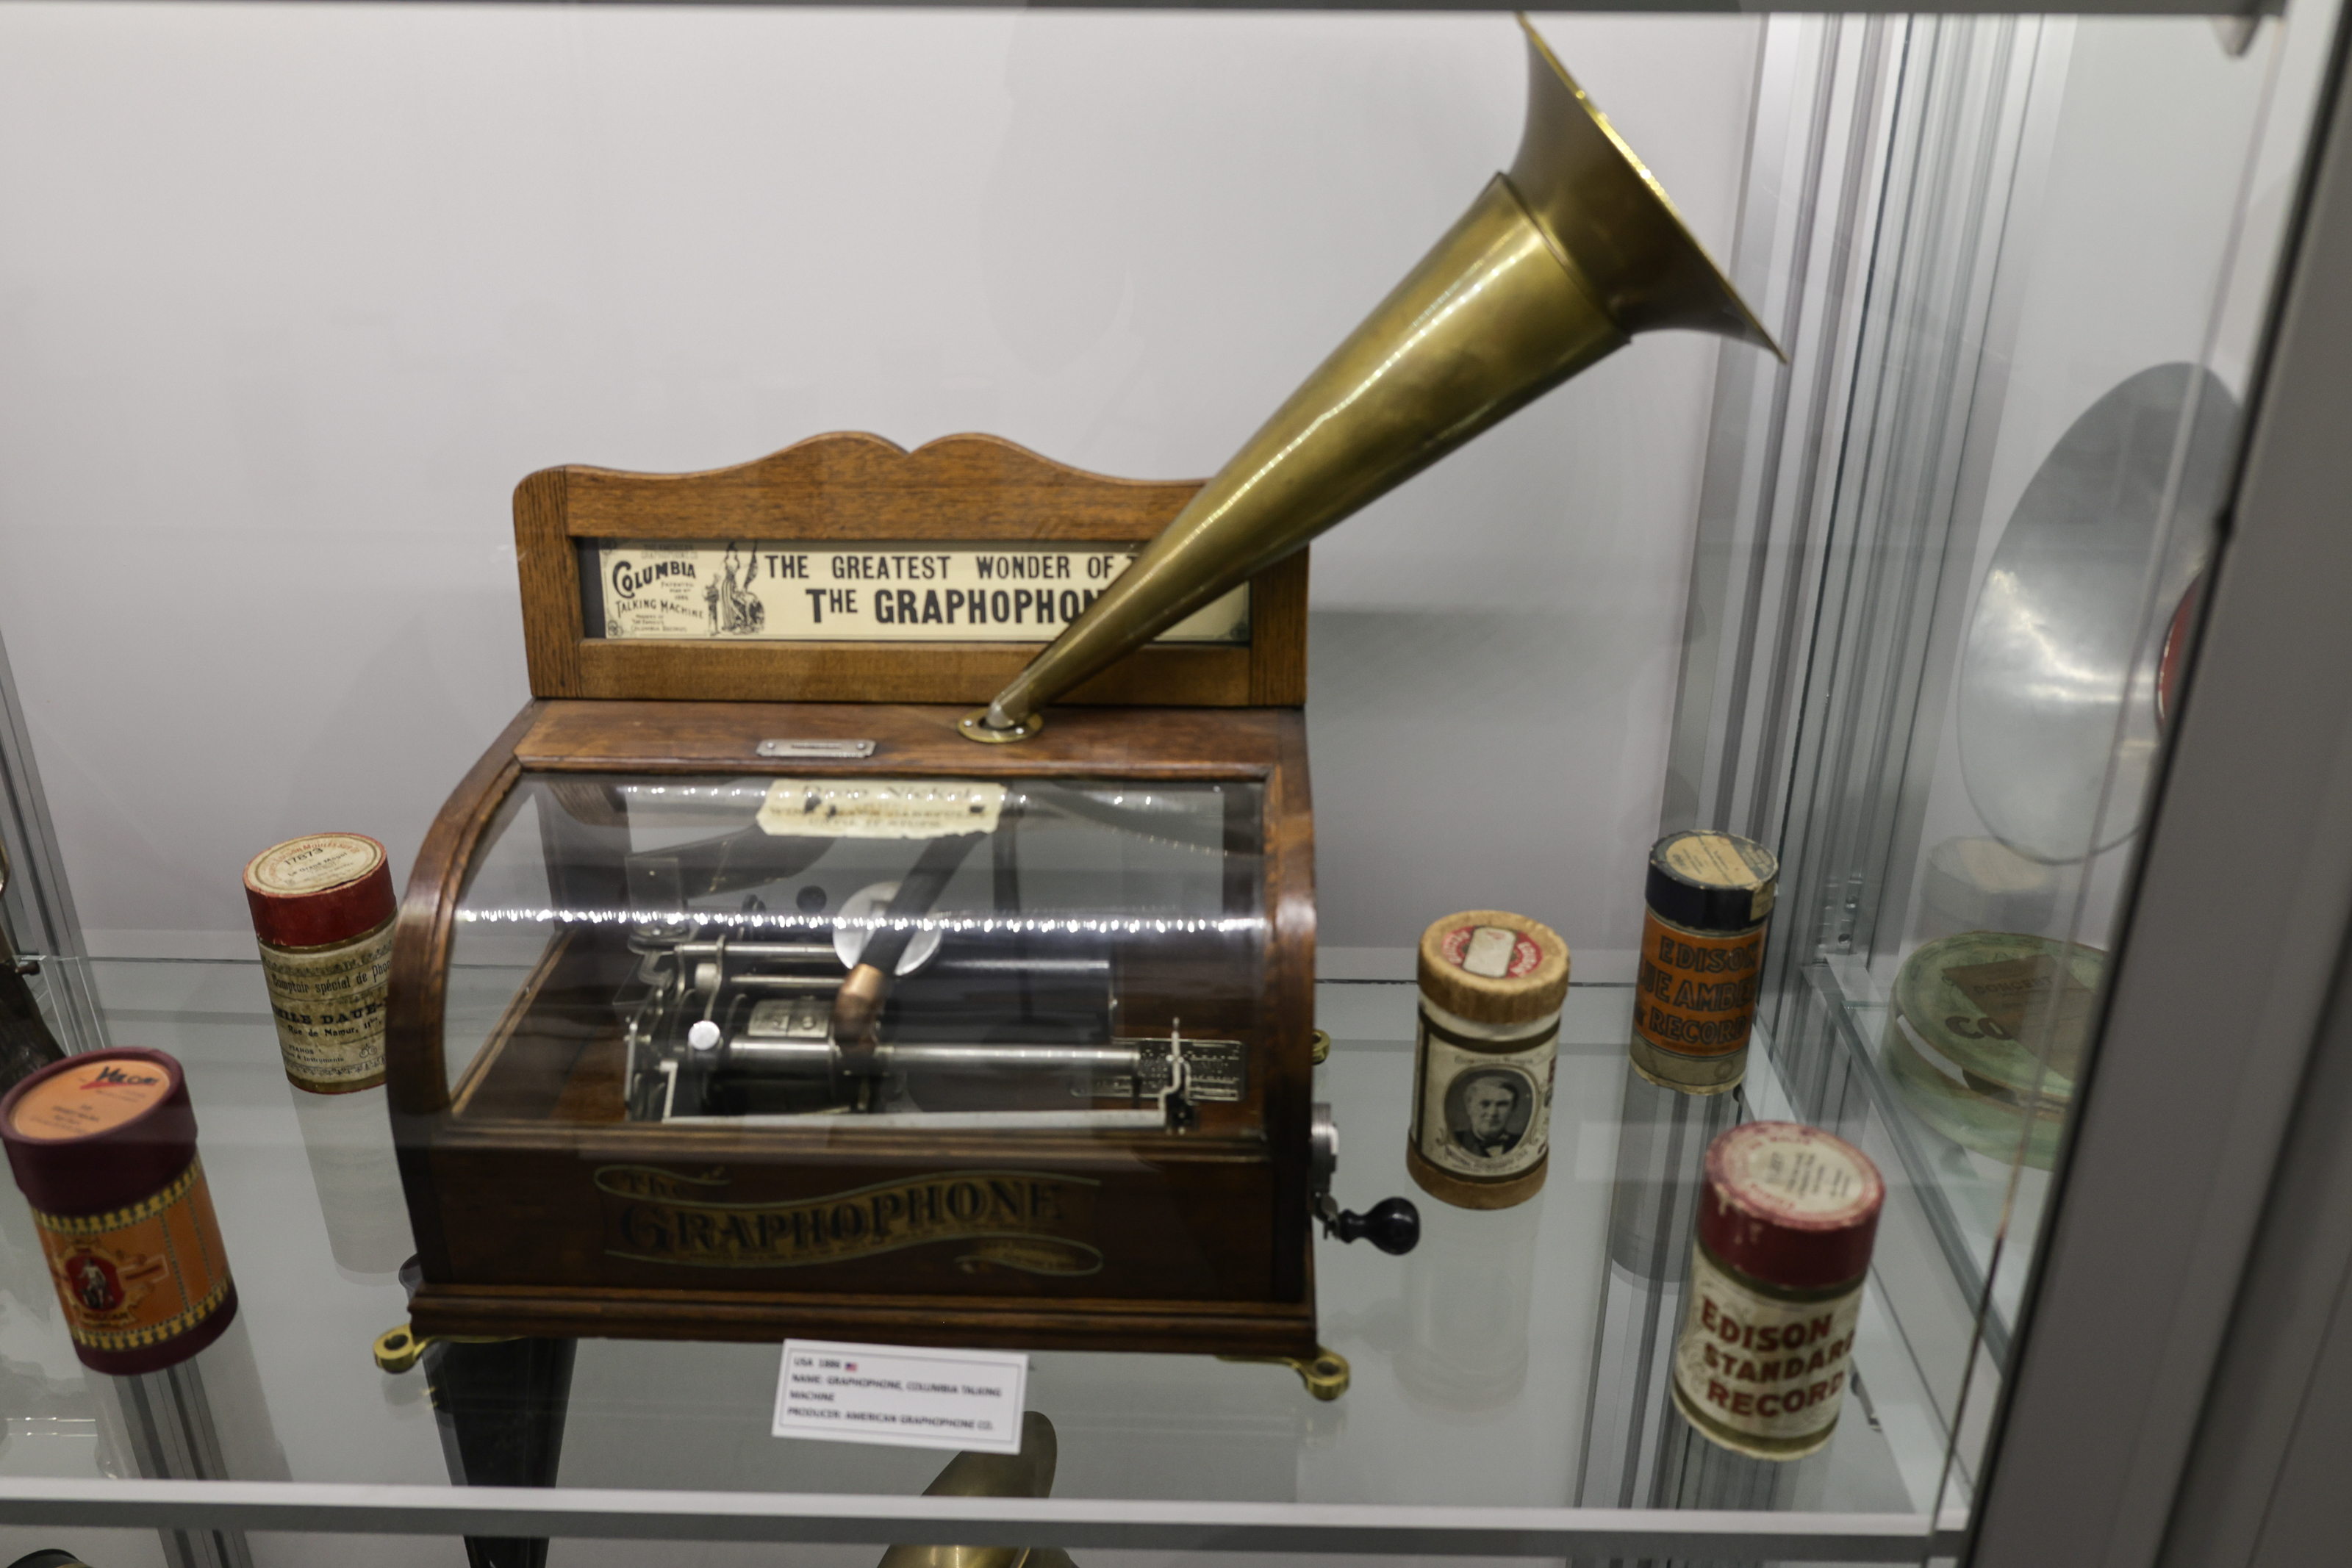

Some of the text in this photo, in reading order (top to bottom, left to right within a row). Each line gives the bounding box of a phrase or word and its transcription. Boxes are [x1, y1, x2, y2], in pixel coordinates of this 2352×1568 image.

[612, 561, 696, 599] COLUMBIA
[764, 555, 809, 578] THE
[831, 555, 951, 580] GREATEST
[976, 555, 1070, 579] WONDER
[1087, 556, 1114, 579] OF
[616, 599, 704, 619] TALKING MACHINE
[806, 589, 1105, 624] THE GRAPHOPHON
[1659, 935, 1760, 974] EDISON
[271, 974, 309, 994] Comptoir
[315, 976, 351, 995] spécial
[356, 971, 368, 985] de
[1673, 972, 1758, 1012] AMBE
[288, 1025, 302, 1036] Rue
[308, 1029, 318, 1037] de
[1649, 1004, 1747, 1046] RECORD
[619, 1180, 1064, 1251] GRAPHOPHONE
[1702, 1294, 1833, 1353] EDISON
[793, 1356, 812, 1368] USA
[789, 1390, 835, 1402] MACHINE
[906, 1381, 957, 1394] COLUMBIA
[961, 1385, 1002, 1398] TALKING
[1707, 1370, 1844, 1418] RECORD
[845, 1411, 897, 1424] AMERICAN
[900, 1414, 975, 1429] GRAPHOPHONE
